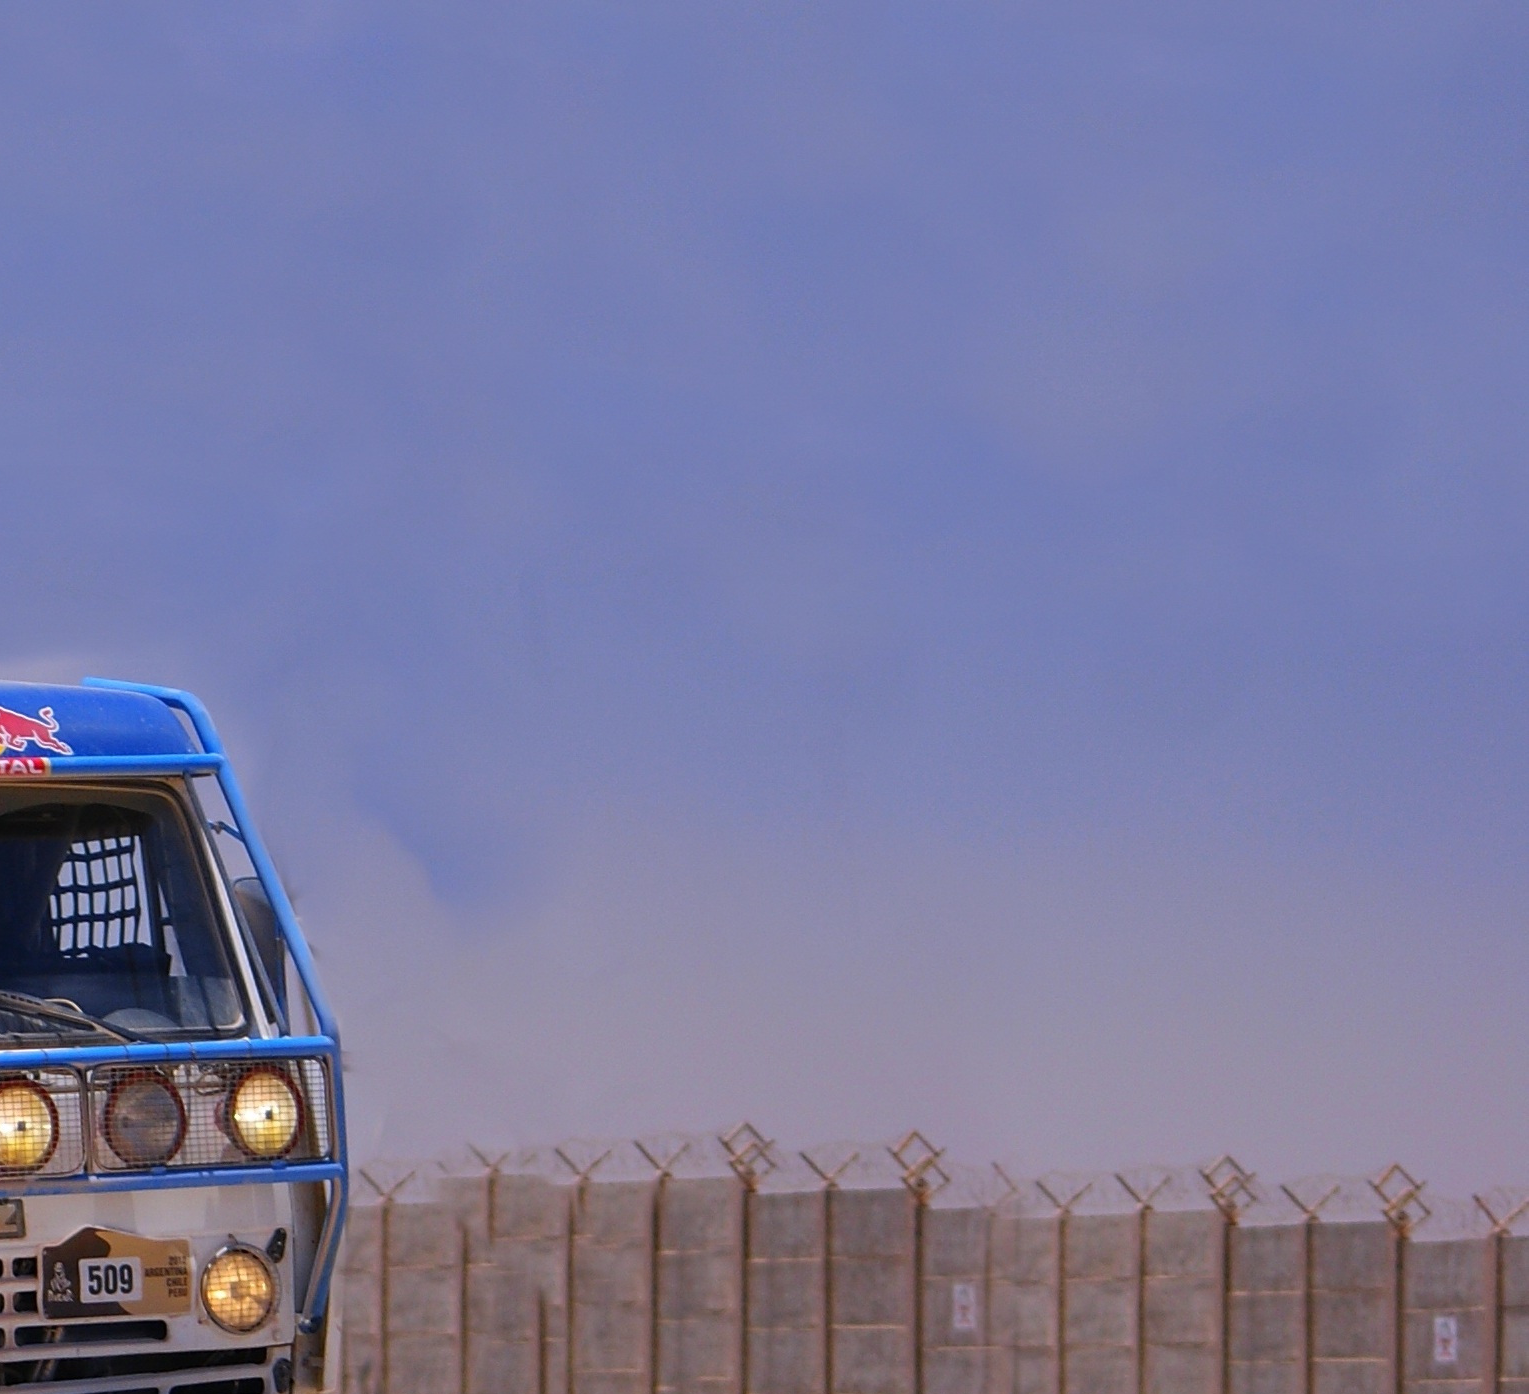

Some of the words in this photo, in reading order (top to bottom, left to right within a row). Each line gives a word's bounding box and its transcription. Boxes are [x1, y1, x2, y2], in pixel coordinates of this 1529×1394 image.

[145, 1267, 187, 1277] ARGENTINA
[88, 1264, 133, 1295] 509
[166, 1277, 187, 1287] CHILE
